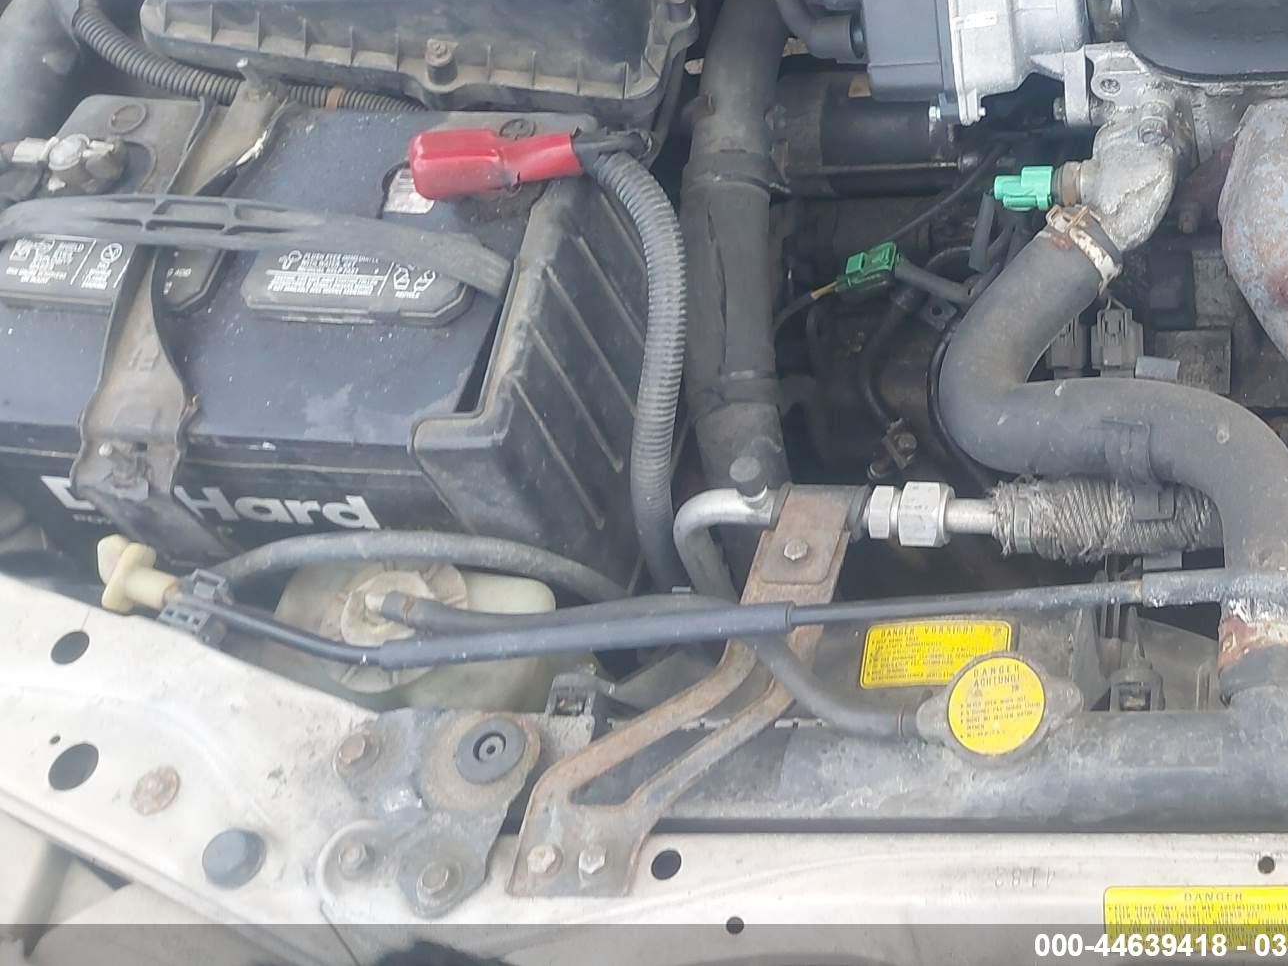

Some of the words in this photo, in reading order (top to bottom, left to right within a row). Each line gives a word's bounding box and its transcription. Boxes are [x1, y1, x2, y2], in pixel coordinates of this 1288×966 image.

[881, 626, 915, 636] DANGER
[973, 664, 1020, 678] DANGER
[1184, 891, 1243, 901] DANGER
